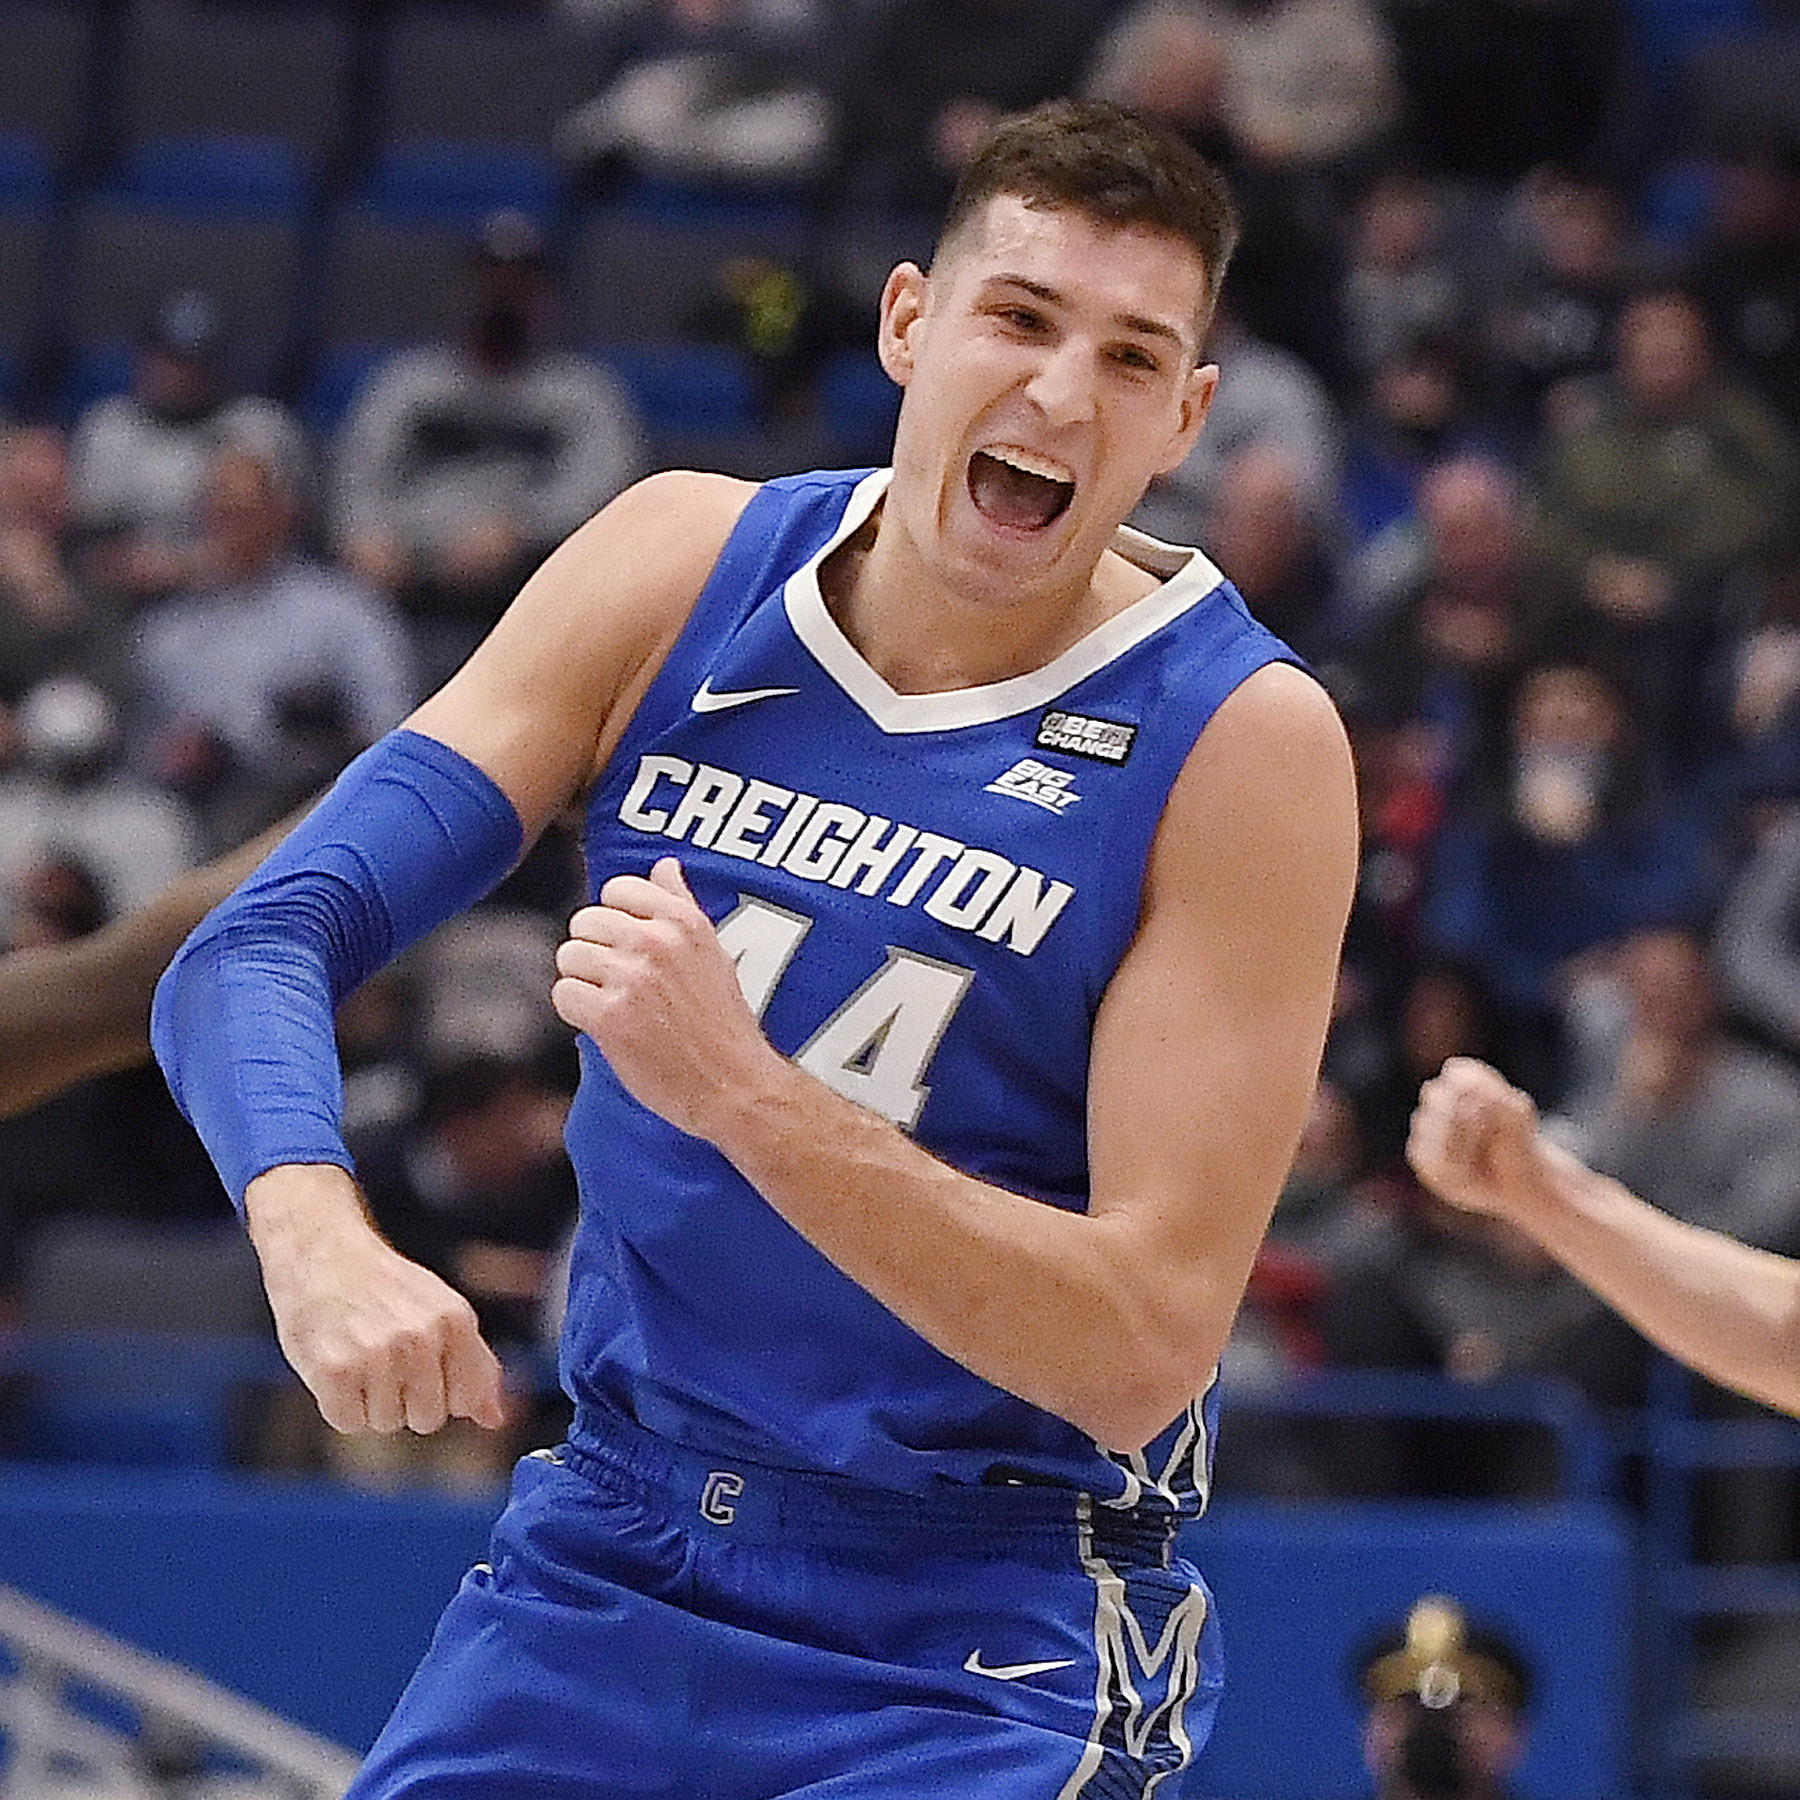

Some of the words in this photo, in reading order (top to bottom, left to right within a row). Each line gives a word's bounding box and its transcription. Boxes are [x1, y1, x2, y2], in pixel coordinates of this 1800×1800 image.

[1038, 730, 1128, 760] CHANGE
[994, 771, 1082, 808] EAST
[1004, 758, 1076, 788] BIG
[618, 755, 1075, 956] CREIGHTON
[699, 1471, 745, 1525] C
